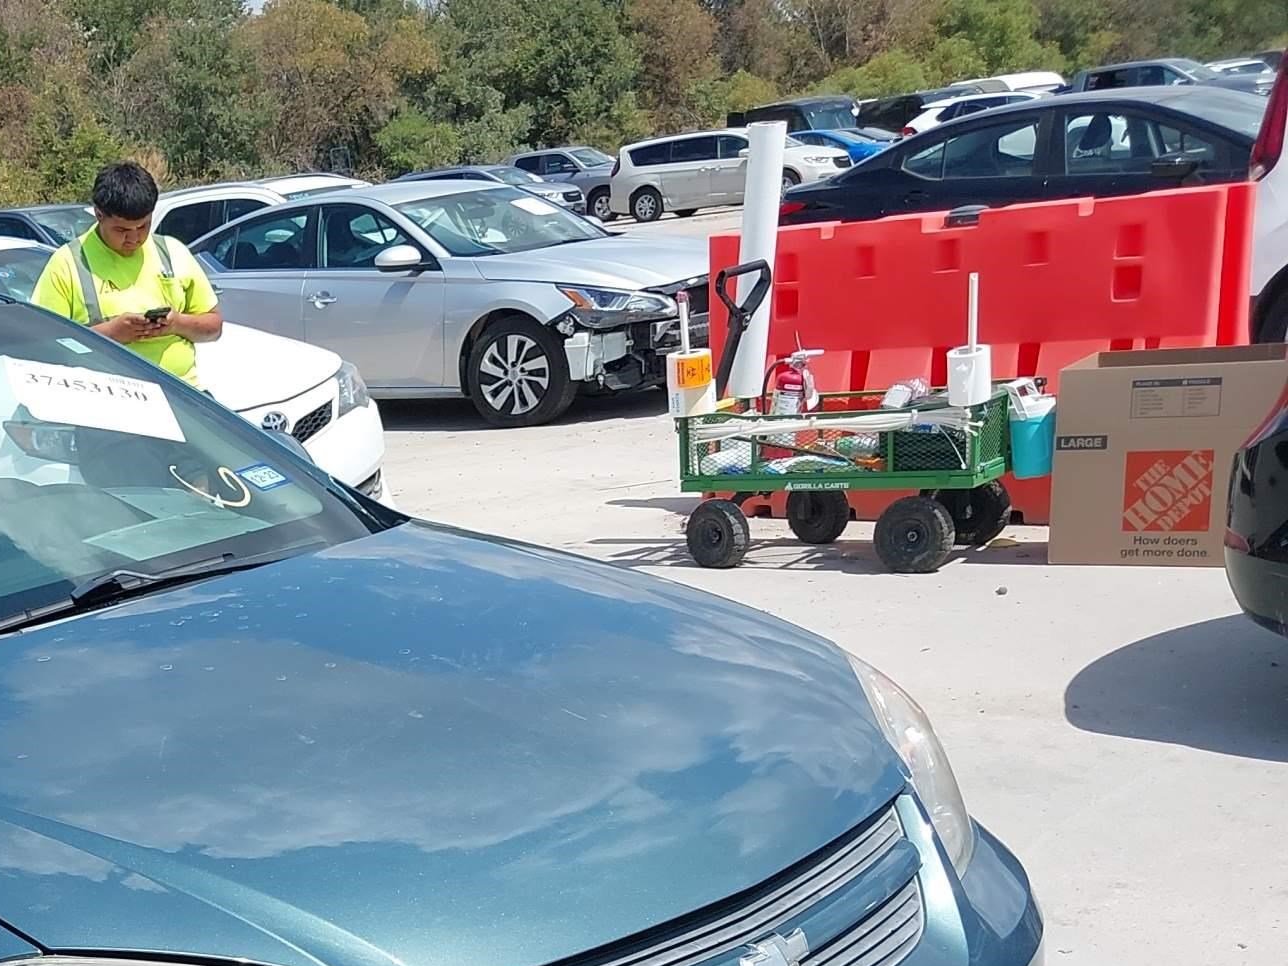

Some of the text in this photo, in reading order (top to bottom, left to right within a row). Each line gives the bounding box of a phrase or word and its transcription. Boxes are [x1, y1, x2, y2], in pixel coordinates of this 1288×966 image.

[25, 373, 148, 402] 37453130
[1061, 437, 1103, 449] LARGE
[1133, 459, 1172, 492] THE
[1124, 450, 1214, 533] HOME
[1155, 480, 1213, 532] DEPOT
[1120, 548, 1139, 559] get
[1142, 550, 1173, 558] more
[1133, 535, 1198, 546] How doers
